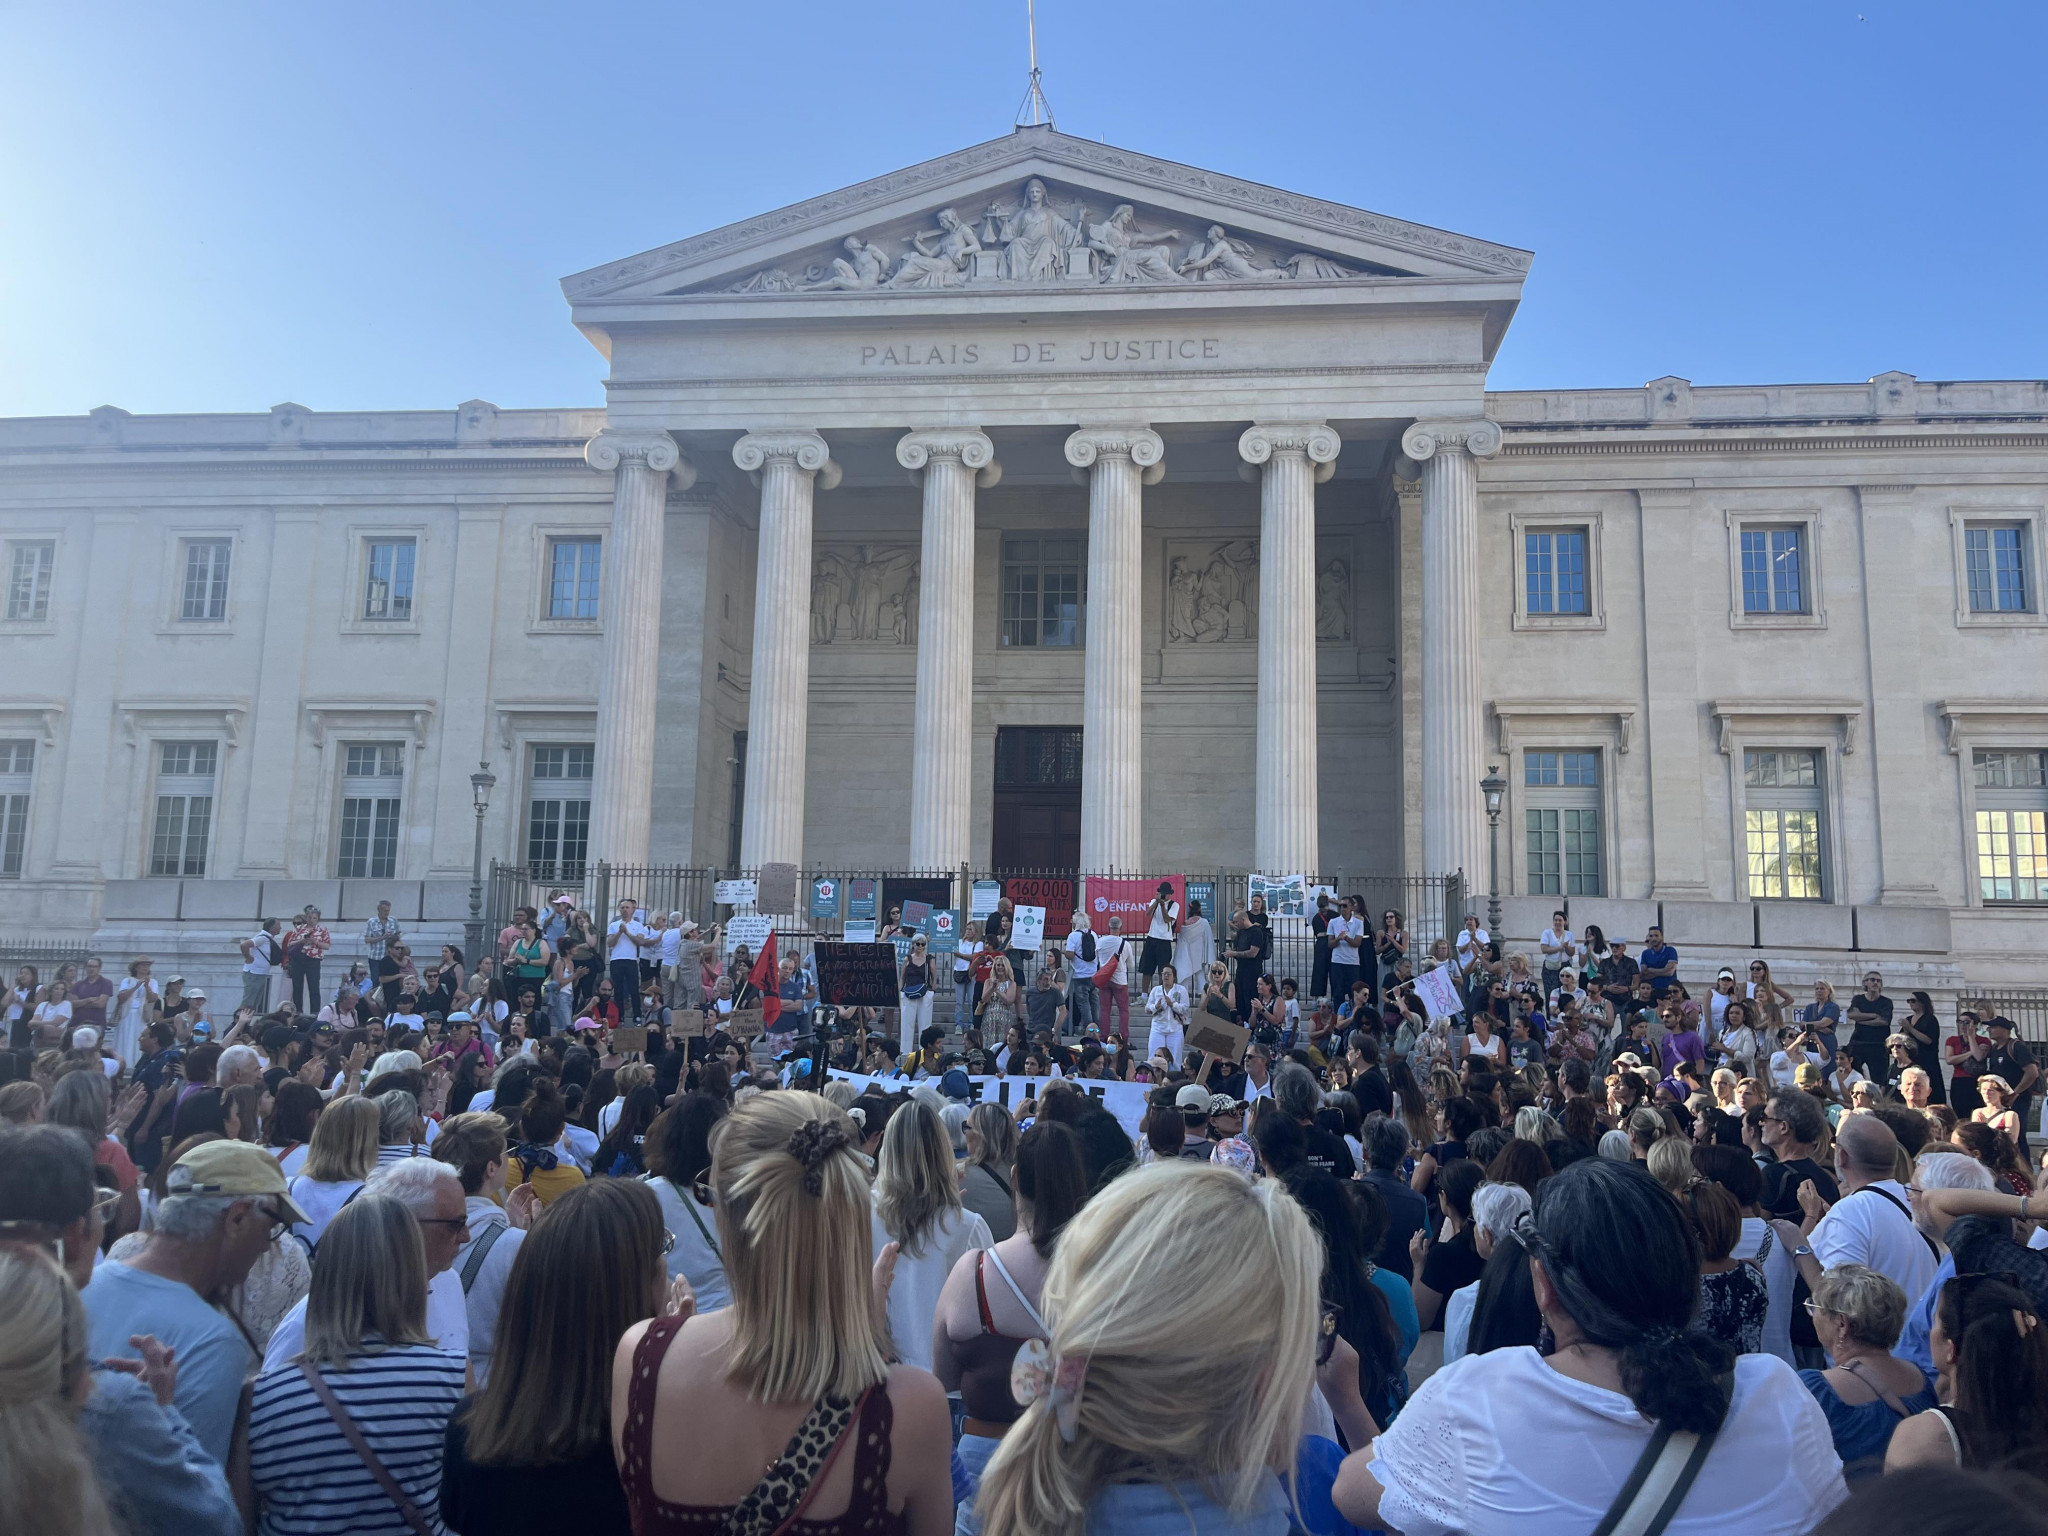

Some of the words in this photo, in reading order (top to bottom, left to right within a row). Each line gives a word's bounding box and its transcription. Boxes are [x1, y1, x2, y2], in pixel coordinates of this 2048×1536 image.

[860, 345, 980, 366] PALAIS
[1012, 343, 1056, 363] DE
[1080, 339, 1220, 361] JUSTICE
[771, 865, 794, 873] STOP
[825, 943, 889, 957] NEMESIS
